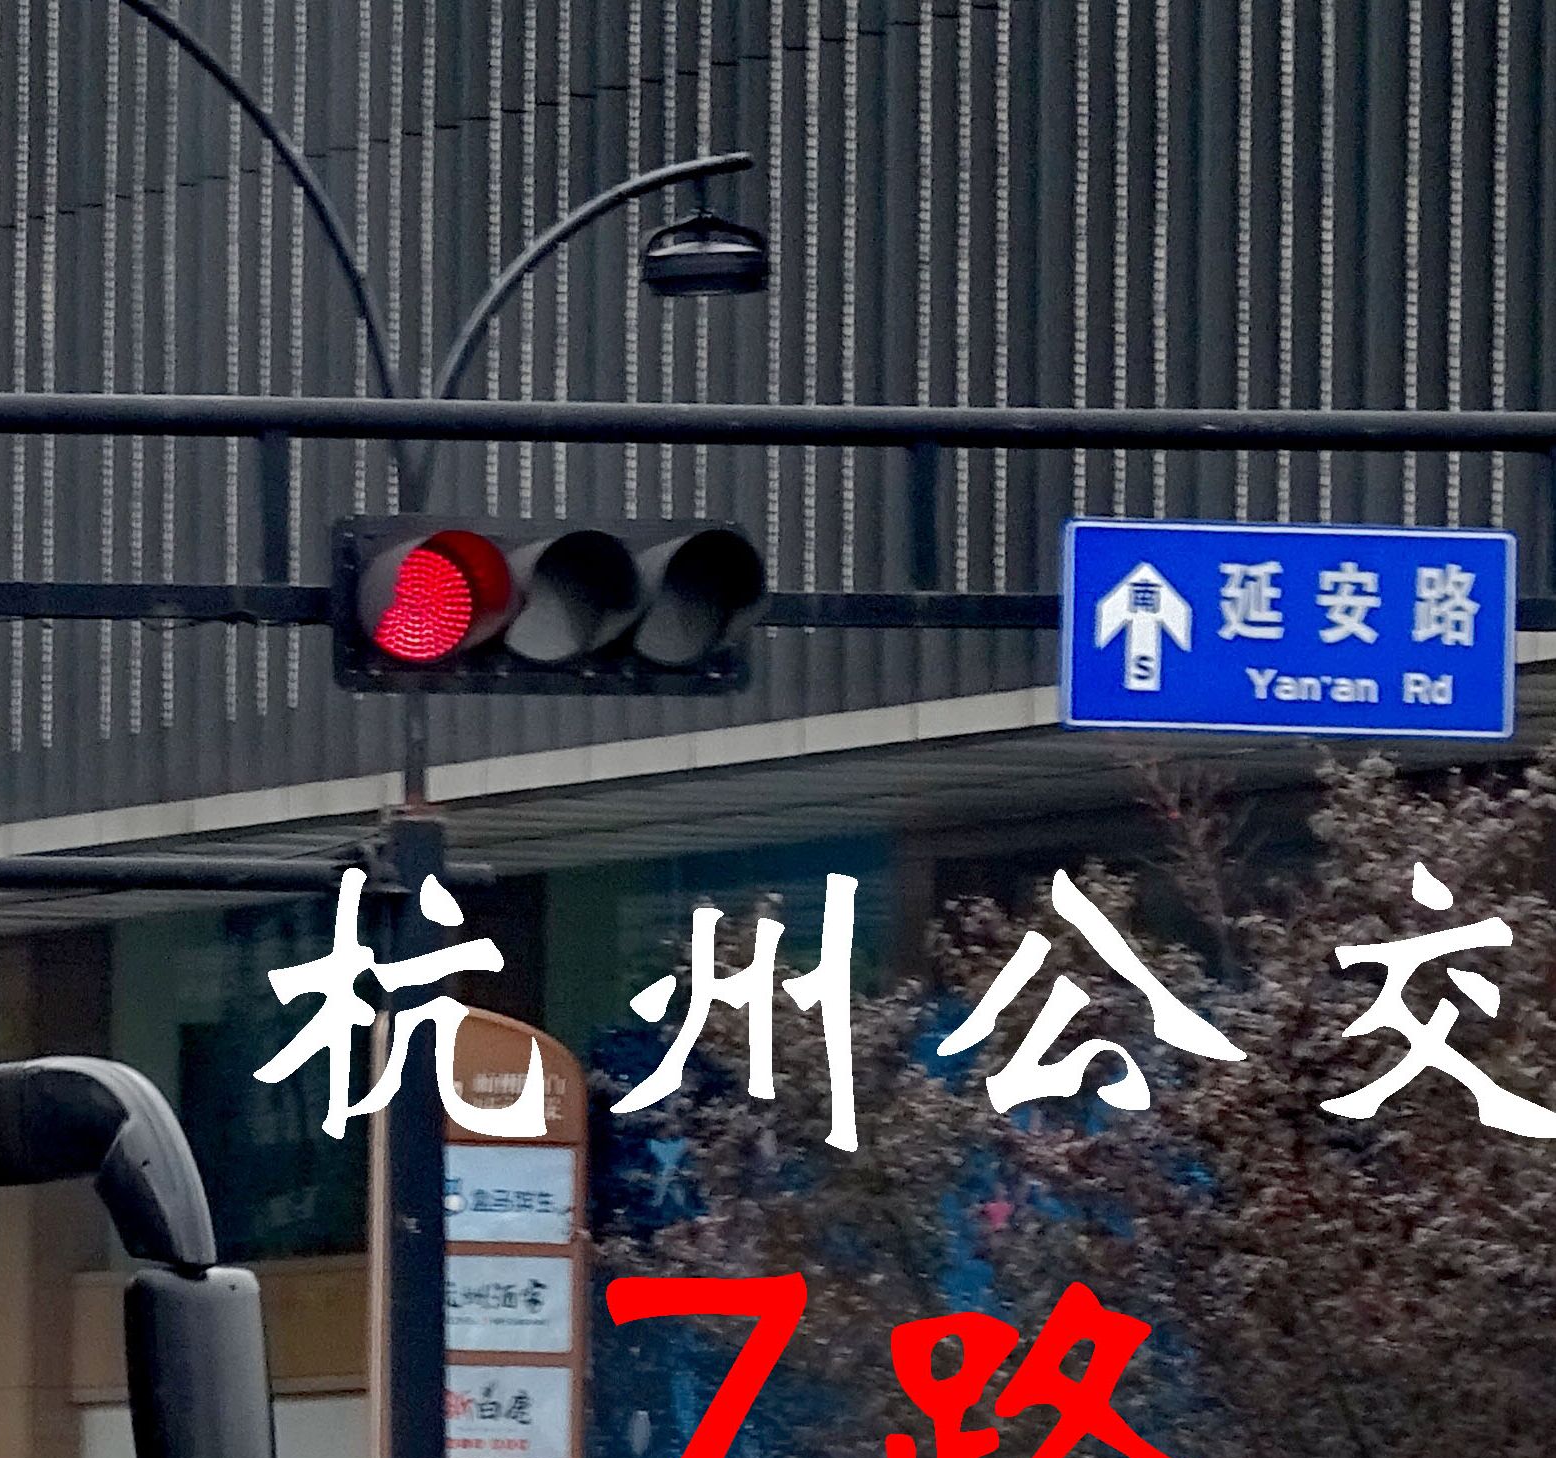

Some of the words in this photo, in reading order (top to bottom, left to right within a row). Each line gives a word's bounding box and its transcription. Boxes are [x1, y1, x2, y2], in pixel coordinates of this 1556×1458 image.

[1217, 561, 1480, 646] 延安路
[1134, 655, 1154, 681] S
[1246, 668, 1379, 703] Yan'an
[1402, 672, 1453, 706] Rd
